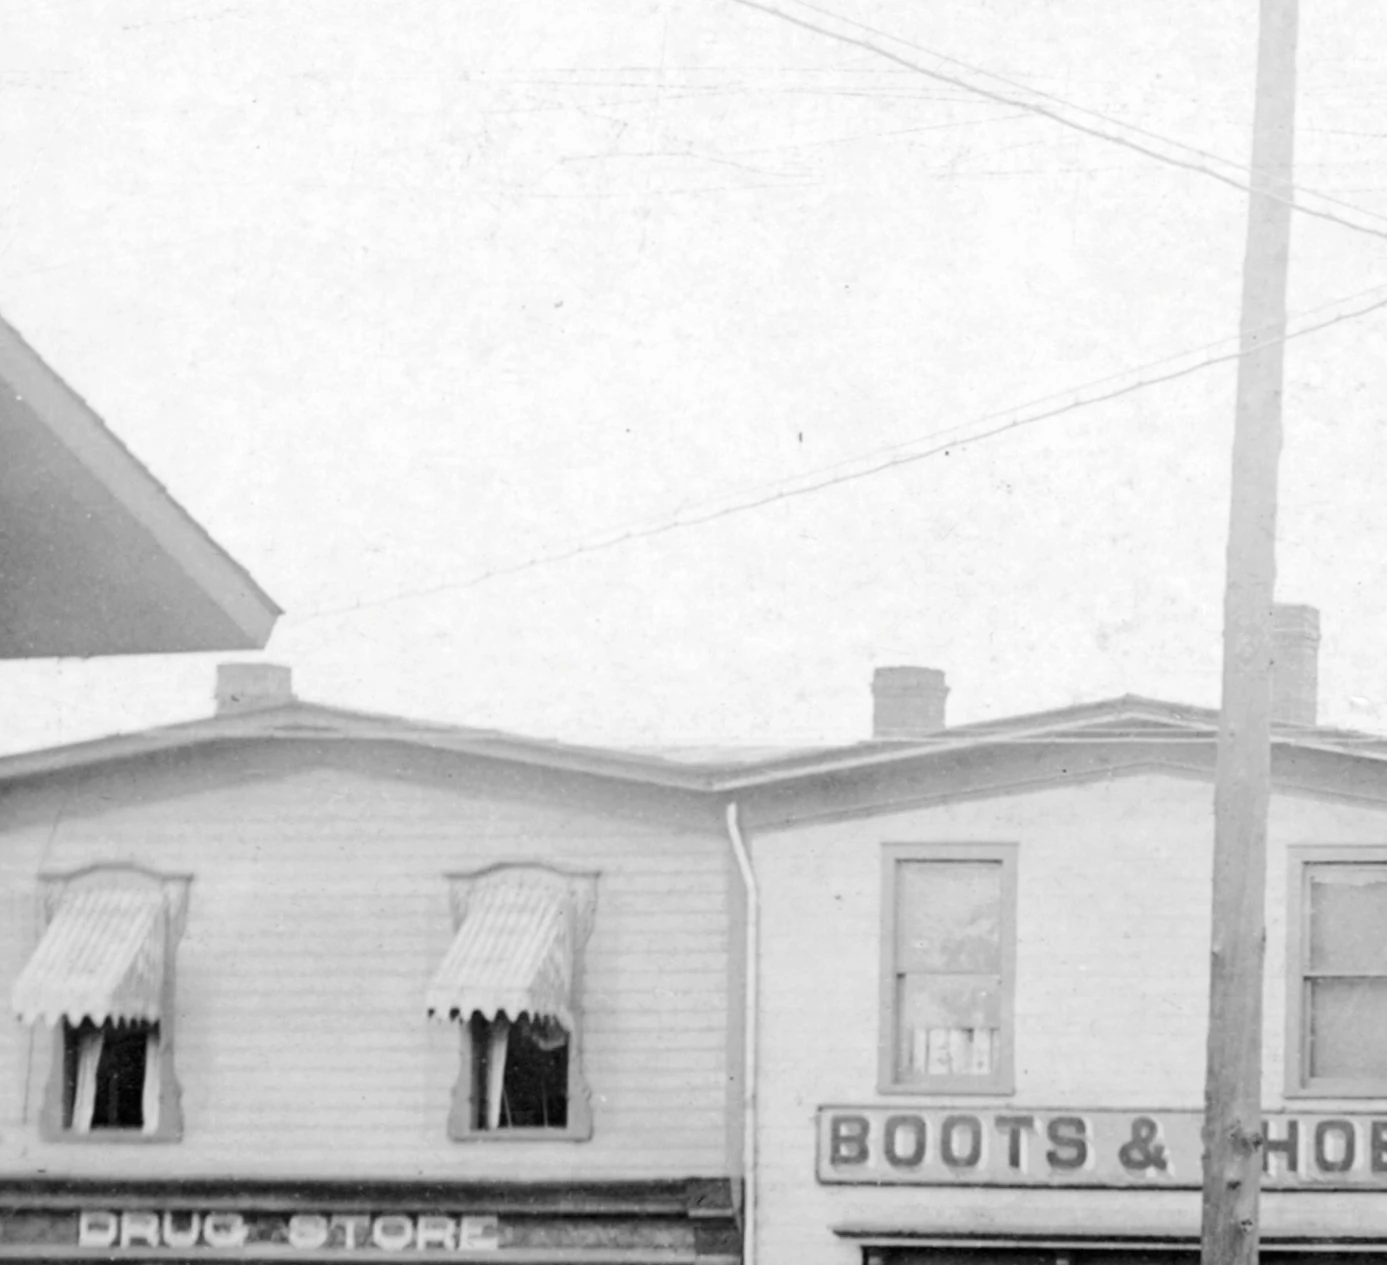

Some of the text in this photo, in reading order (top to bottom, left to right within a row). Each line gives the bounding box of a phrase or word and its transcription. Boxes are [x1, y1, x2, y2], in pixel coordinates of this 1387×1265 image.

[829, 1114, 1092, 1170] BOOTS
[1117, 1116, 1170, 1172] &
[78, 1210, 499, 1252] DRUG STORE
